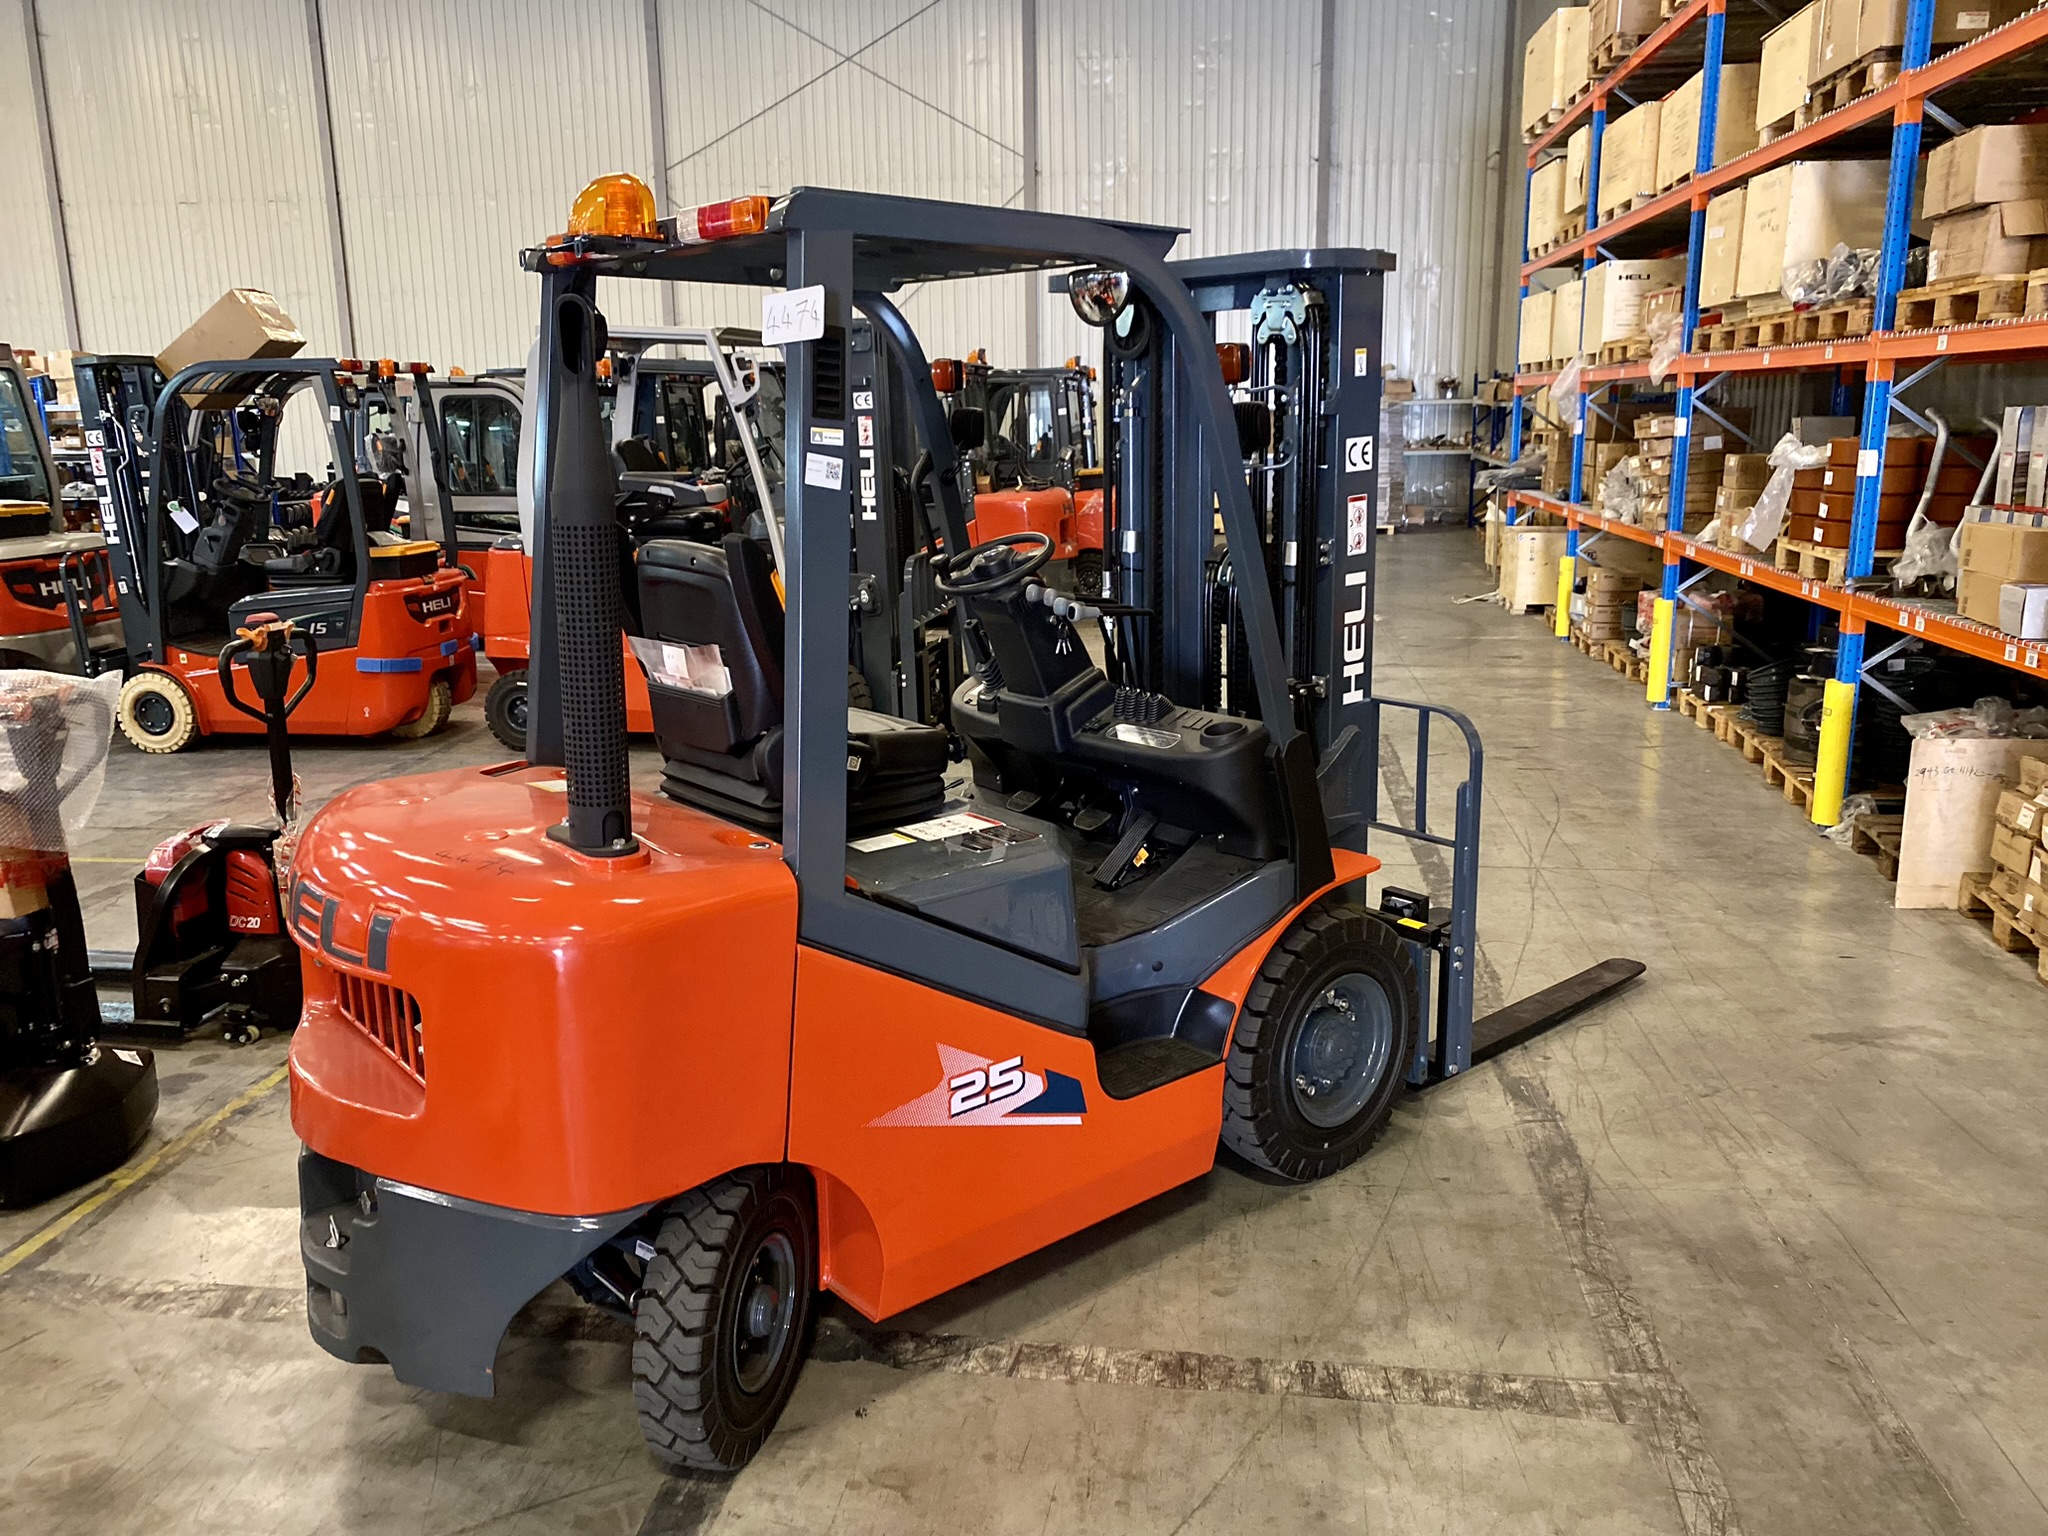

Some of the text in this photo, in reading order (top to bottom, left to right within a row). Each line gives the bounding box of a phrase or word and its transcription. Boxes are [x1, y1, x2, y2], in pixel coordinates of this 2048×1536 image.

[766, 299, 821, 335] 4474
[1348, 441, 1371, 467] CE
[859, 449, 877, 520] HELI
[94, 477, 121, 545] HELI
[309, 622, 328, 635] 15
[422, 597, 451, 613] HELI
[1342, 571, 1367, 706] HELI
[950, 1055, 1025, 1118] 25
